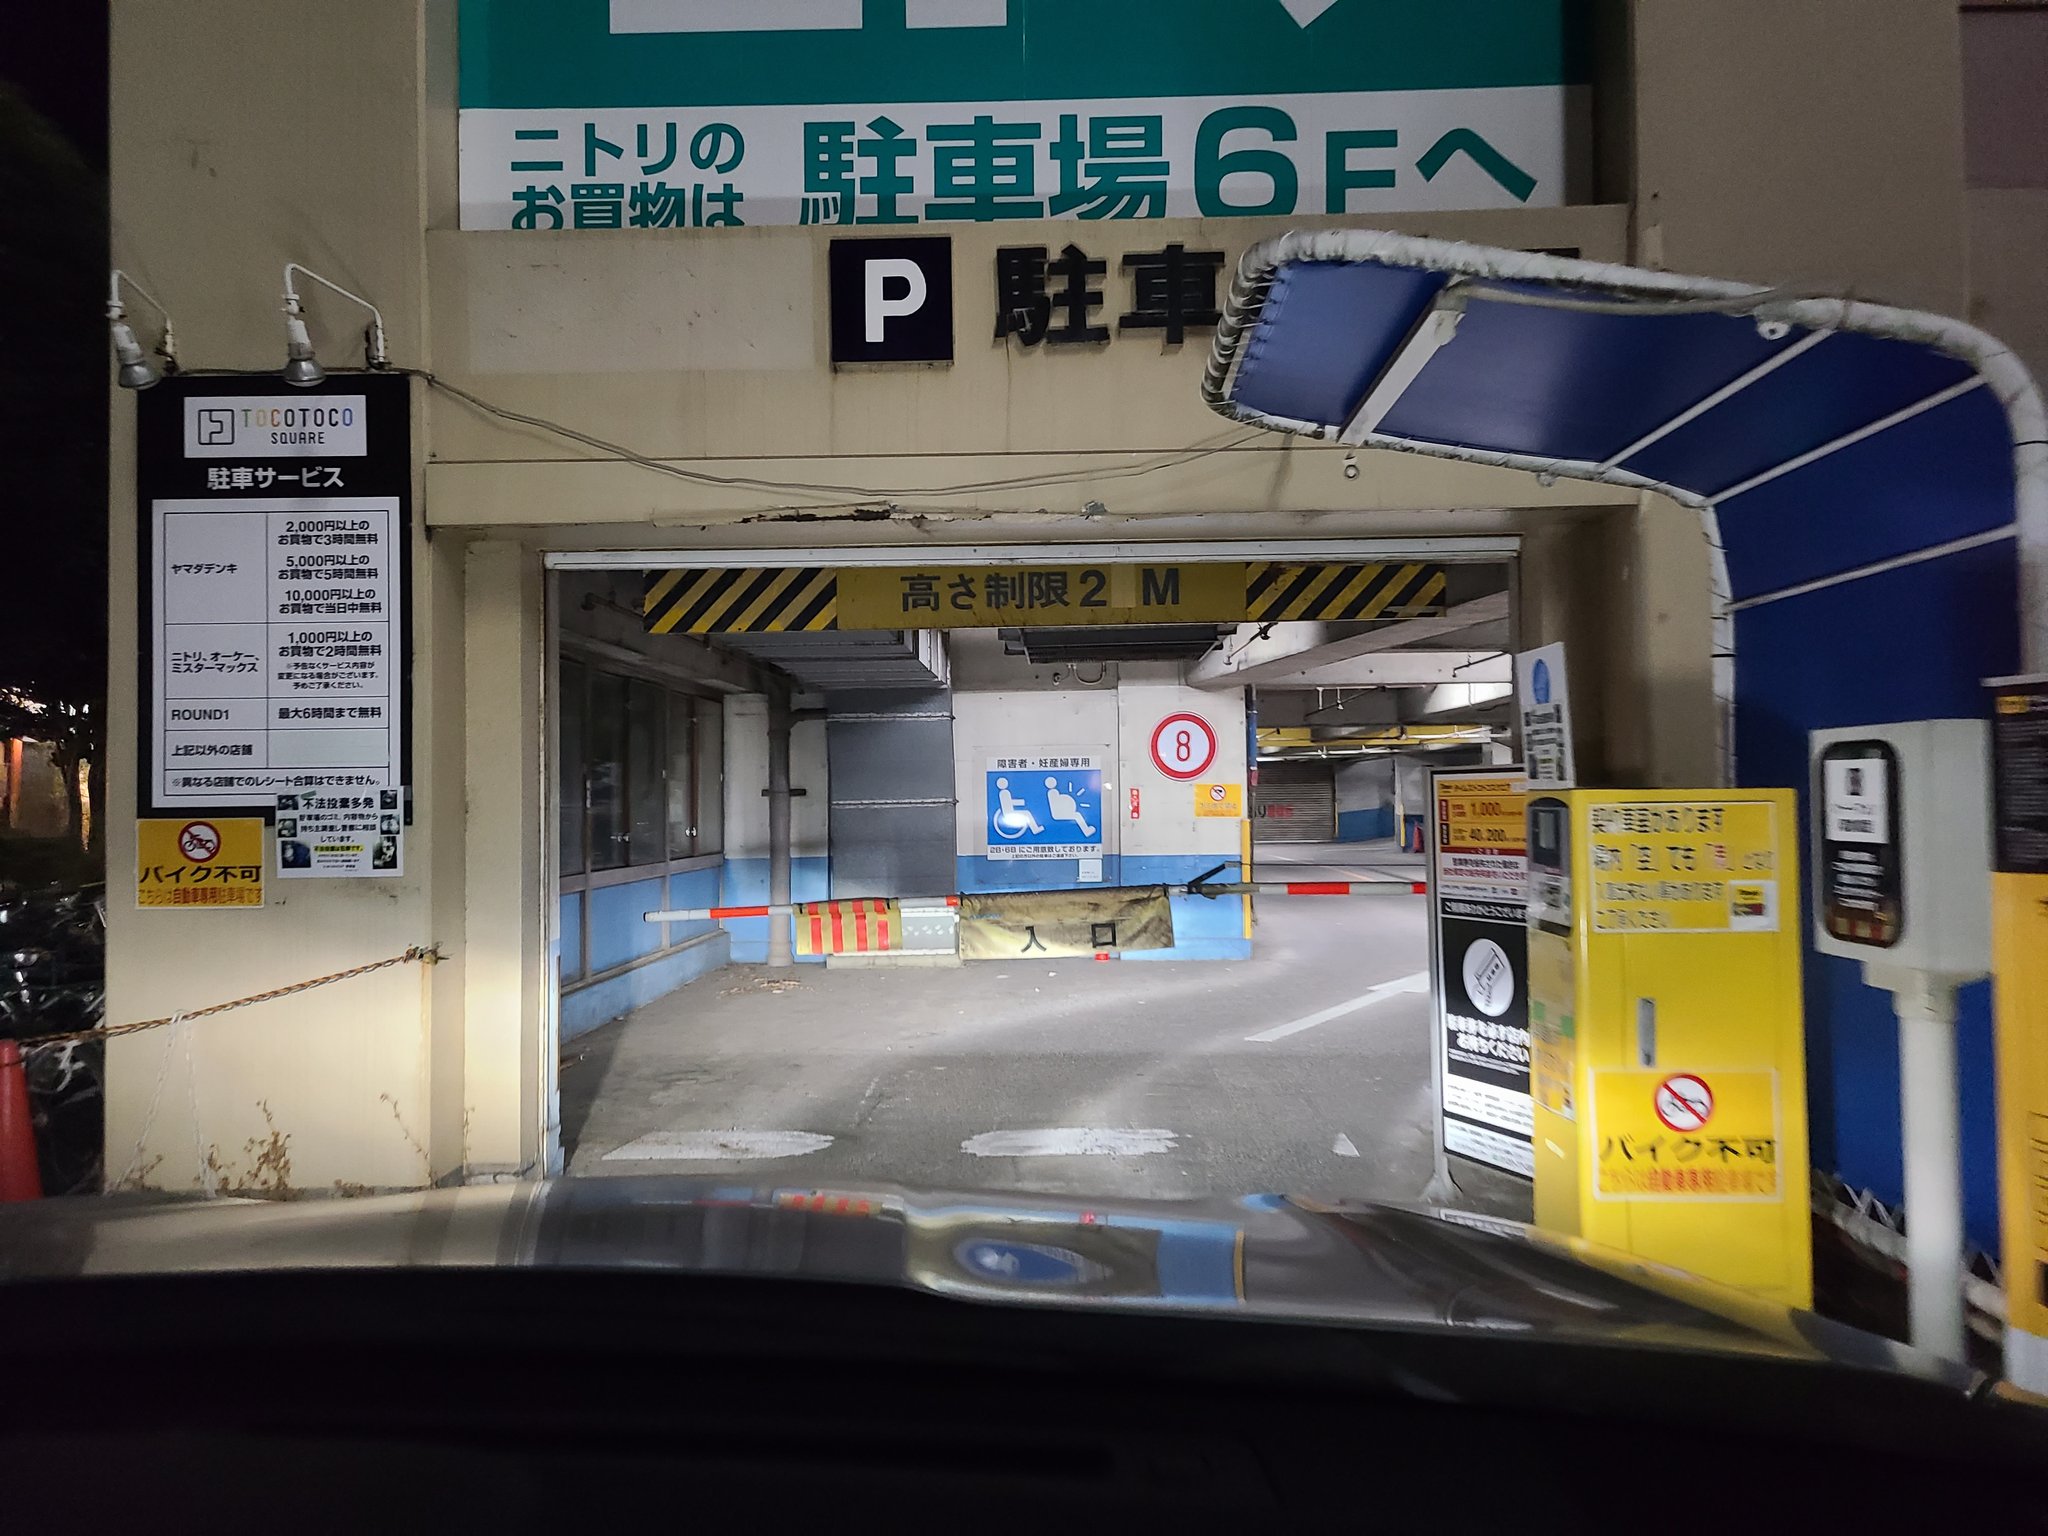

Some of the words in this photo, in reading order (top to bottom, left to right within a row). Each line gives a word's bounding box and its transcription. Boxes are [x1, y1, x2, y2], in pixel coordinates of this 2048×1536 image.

[511, 122, 745, 176] ニトリの
[511, 182, 745, 229] お買物は
[864, 258, 927, 343] P
[241, 408, 354, 428] TOCOTOCO
[270, 432, 326, 445] SQUARE
[207, 466, 345, 490] 駐車サービス
[286, 520, 370, 533] 2,000円以上の
[278, 533, 379, 546] お買物で3時間無料
[286, 554, 370, 568] 5,000円以上の
[171, 562, 238, 575] ヤマダデンキ
[278, 568, 379, 580] お買物で5時間無料
[285, 588, 376, 603] 10,000円以上の
[279, 602, 382, 614] お買物で当日中無料
[288, 631, 373, 645] 1,000円以上の
[279, 644, 382, 657] お買物で2時間無料
[171, 662, 258, 673] ミスターマックス
[171, 709, 230, 721] ROUND1
[278, 707, 382, 719] 最大6時間まで無料
[171, 744, 253, 756] 上記以外の店舗
[1175, 730, 1191, 763] 8
[996, 757, 1090, 769] 障害者・妊産婦専用
[139, 865, 262, 884] バイク不可
